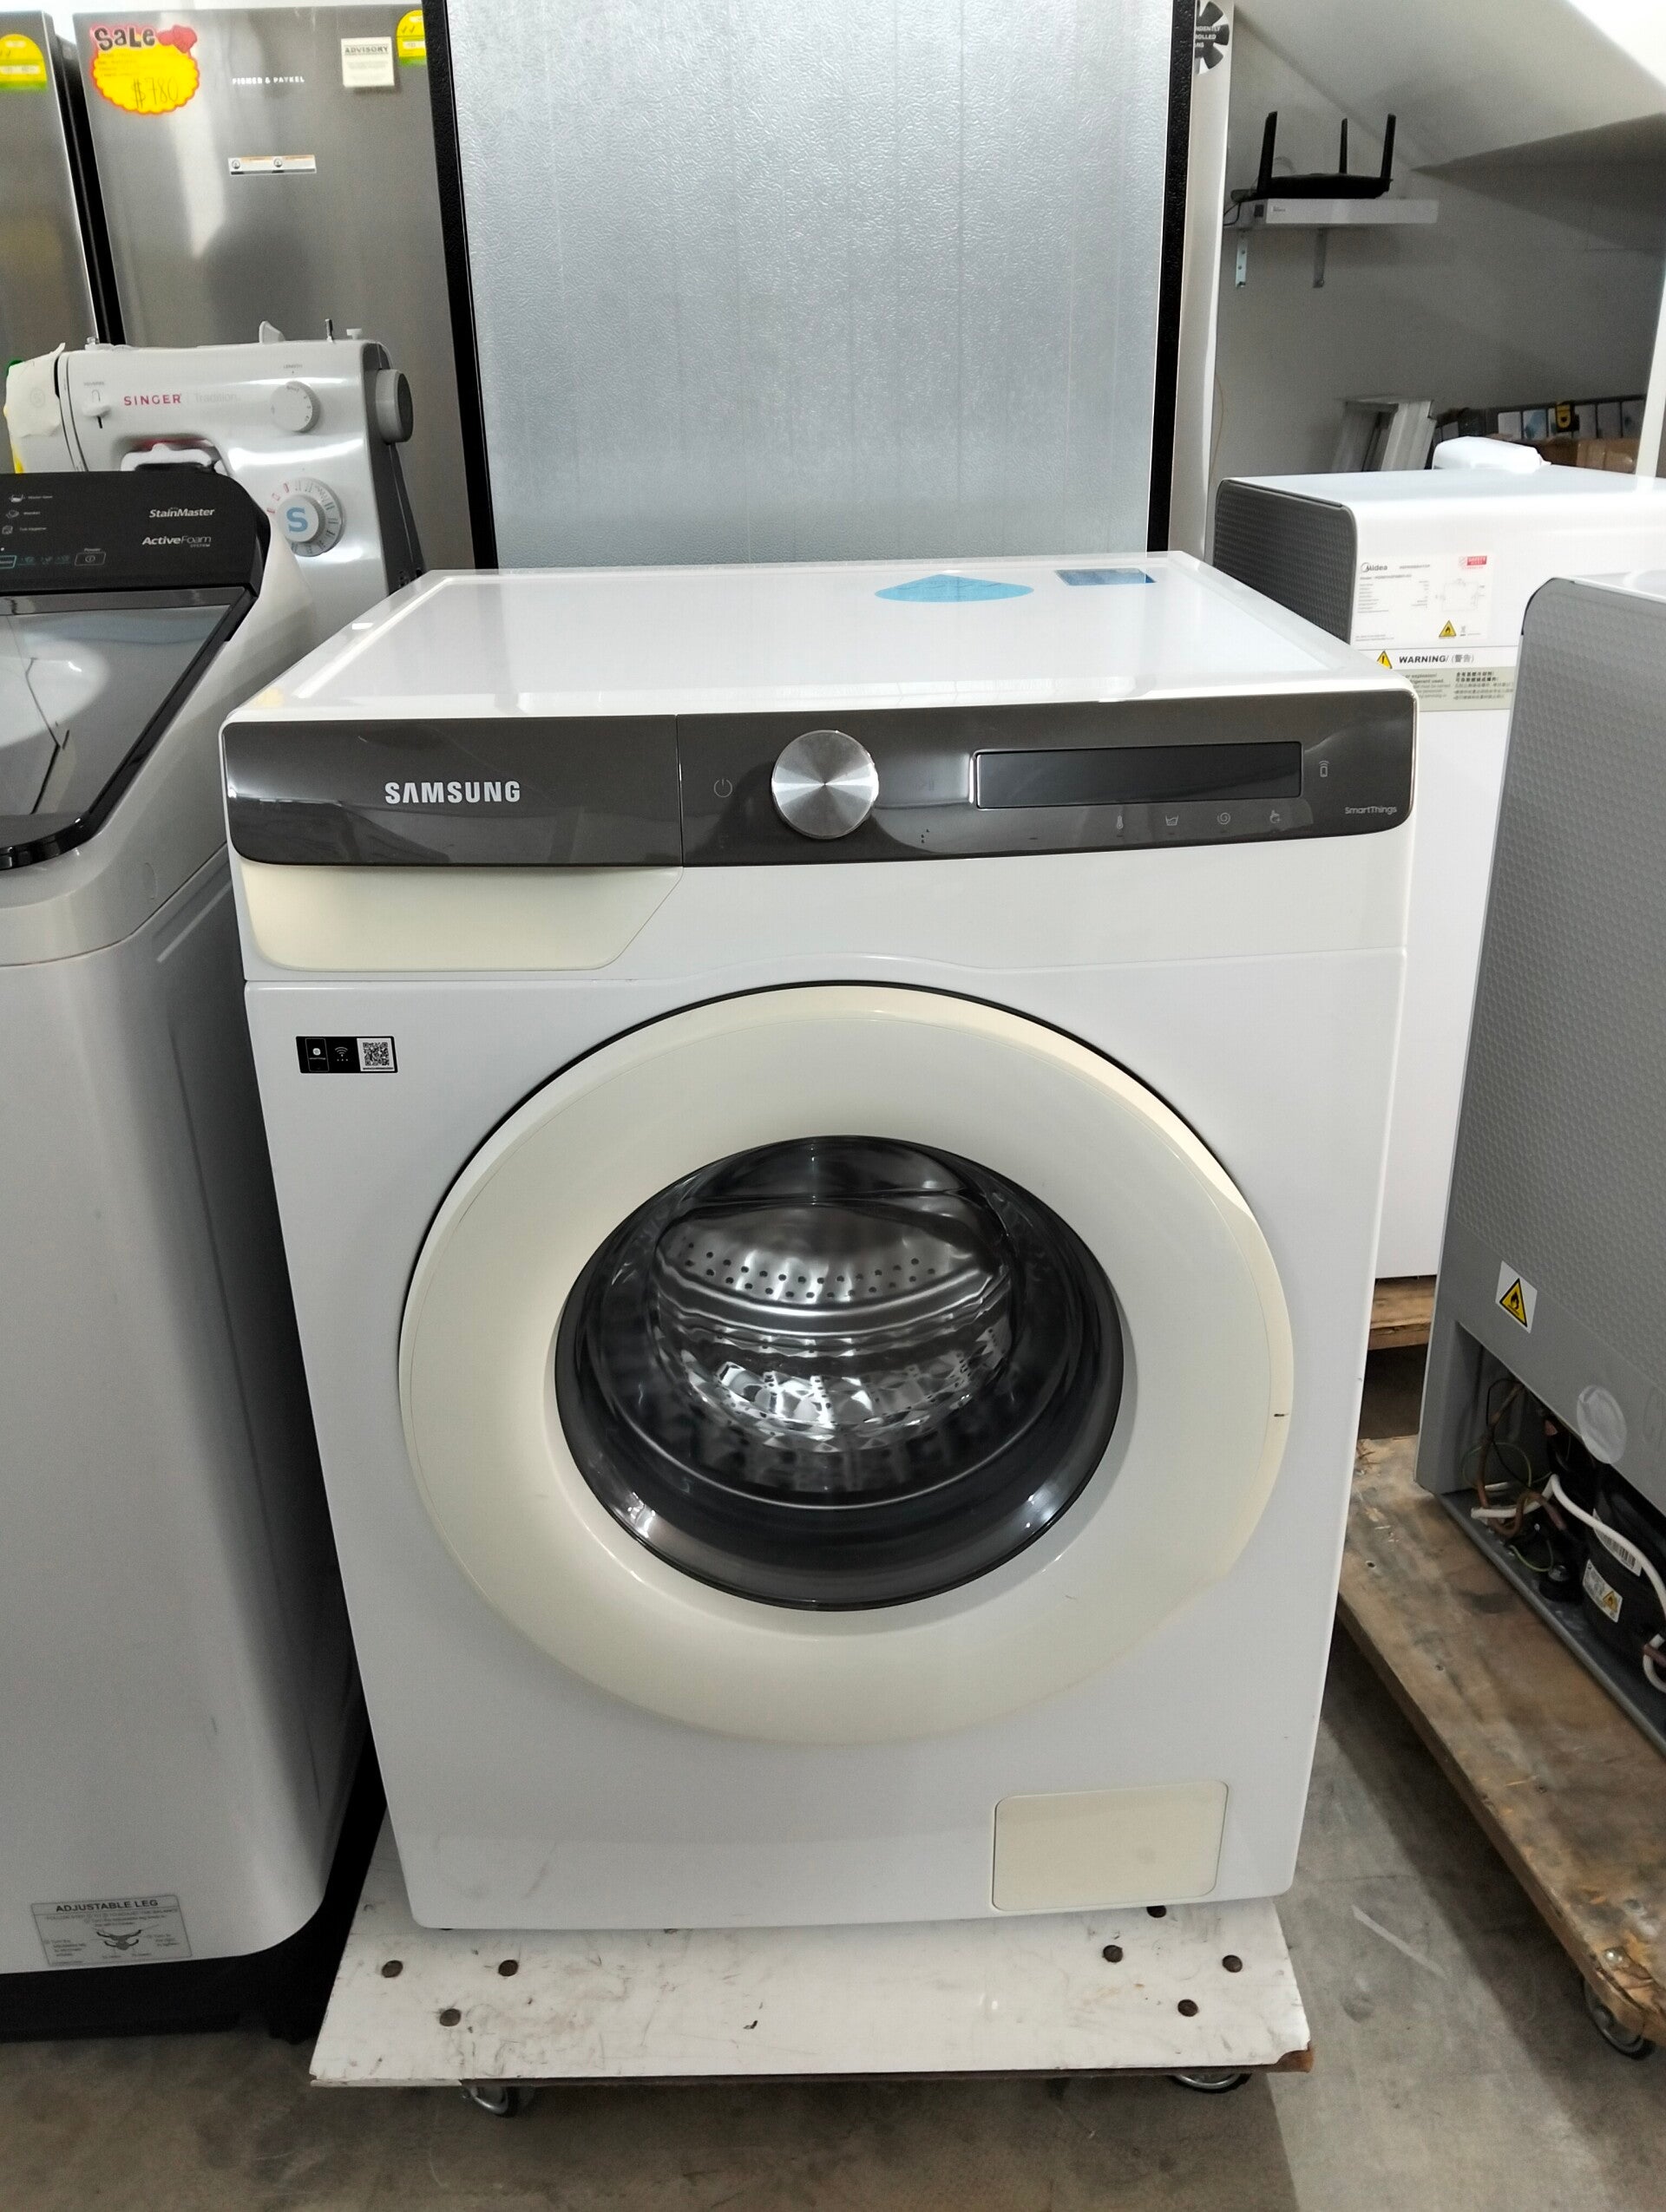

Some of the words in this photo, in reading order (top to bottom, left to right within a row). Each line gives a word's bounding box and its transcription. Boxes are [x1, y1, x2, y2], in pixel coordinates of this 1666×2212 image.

[272, 75, 305, 84] PAYKEL
[123, 394, 181, 406] SINGER
[148, 507, 215, 519] StainMaster
[285, 507, 309, 533] S
[141, 535, 212, 546] ActiveFoam
[1361, 562, 1388, 573] Midea
[384, 780, 521, 804] SAMSUNG
[1344, 806, 1397, 815] SmartThings
[56, 1900, 132, 1913] ADJUSTABLE
[134, 1899, 159, 1908] LEG
